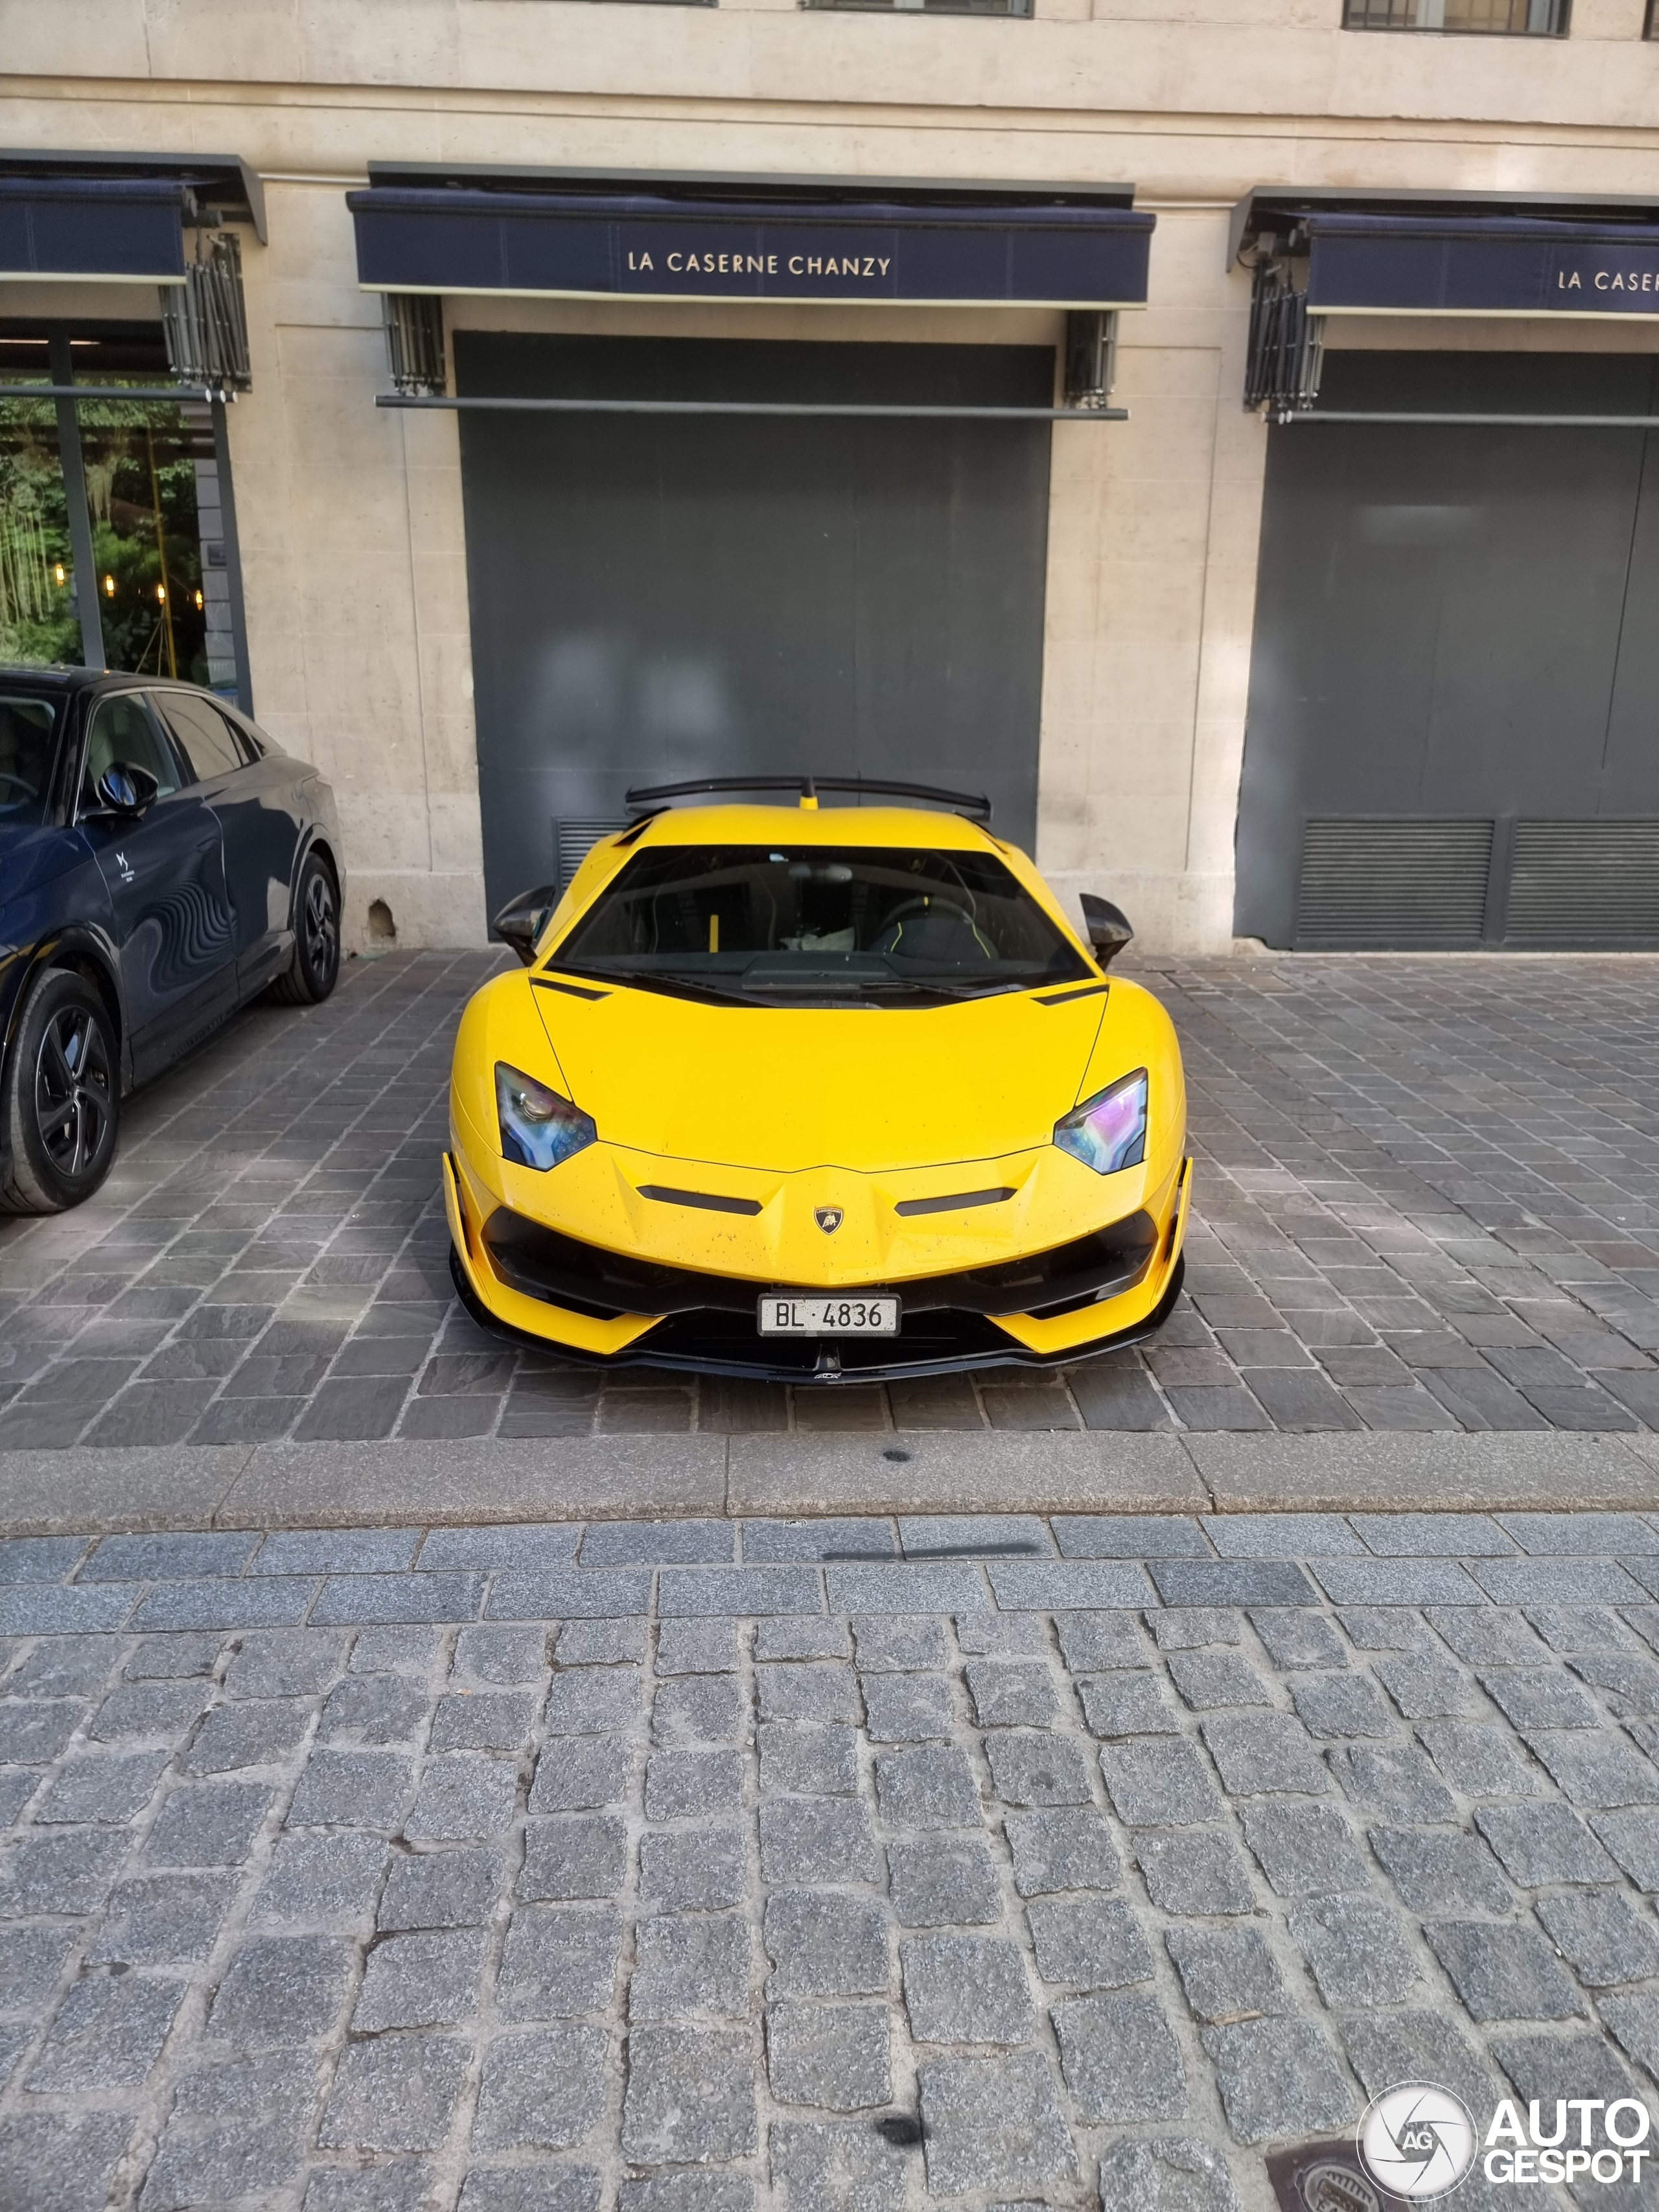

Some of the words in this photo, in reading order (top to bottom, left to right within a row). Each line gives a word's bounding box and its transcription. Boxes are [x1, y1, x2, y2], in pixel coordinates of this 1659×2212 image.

[628, 251, 654, 271] LA
[667, 252, 778, 274] CASERNE
[788, 256, 891, 277] CHANZY
[1559, 271, 1581, 289] LA
[776, 1302, 804, 1327] BL
[822, 1302, 882, 1327] 4836
